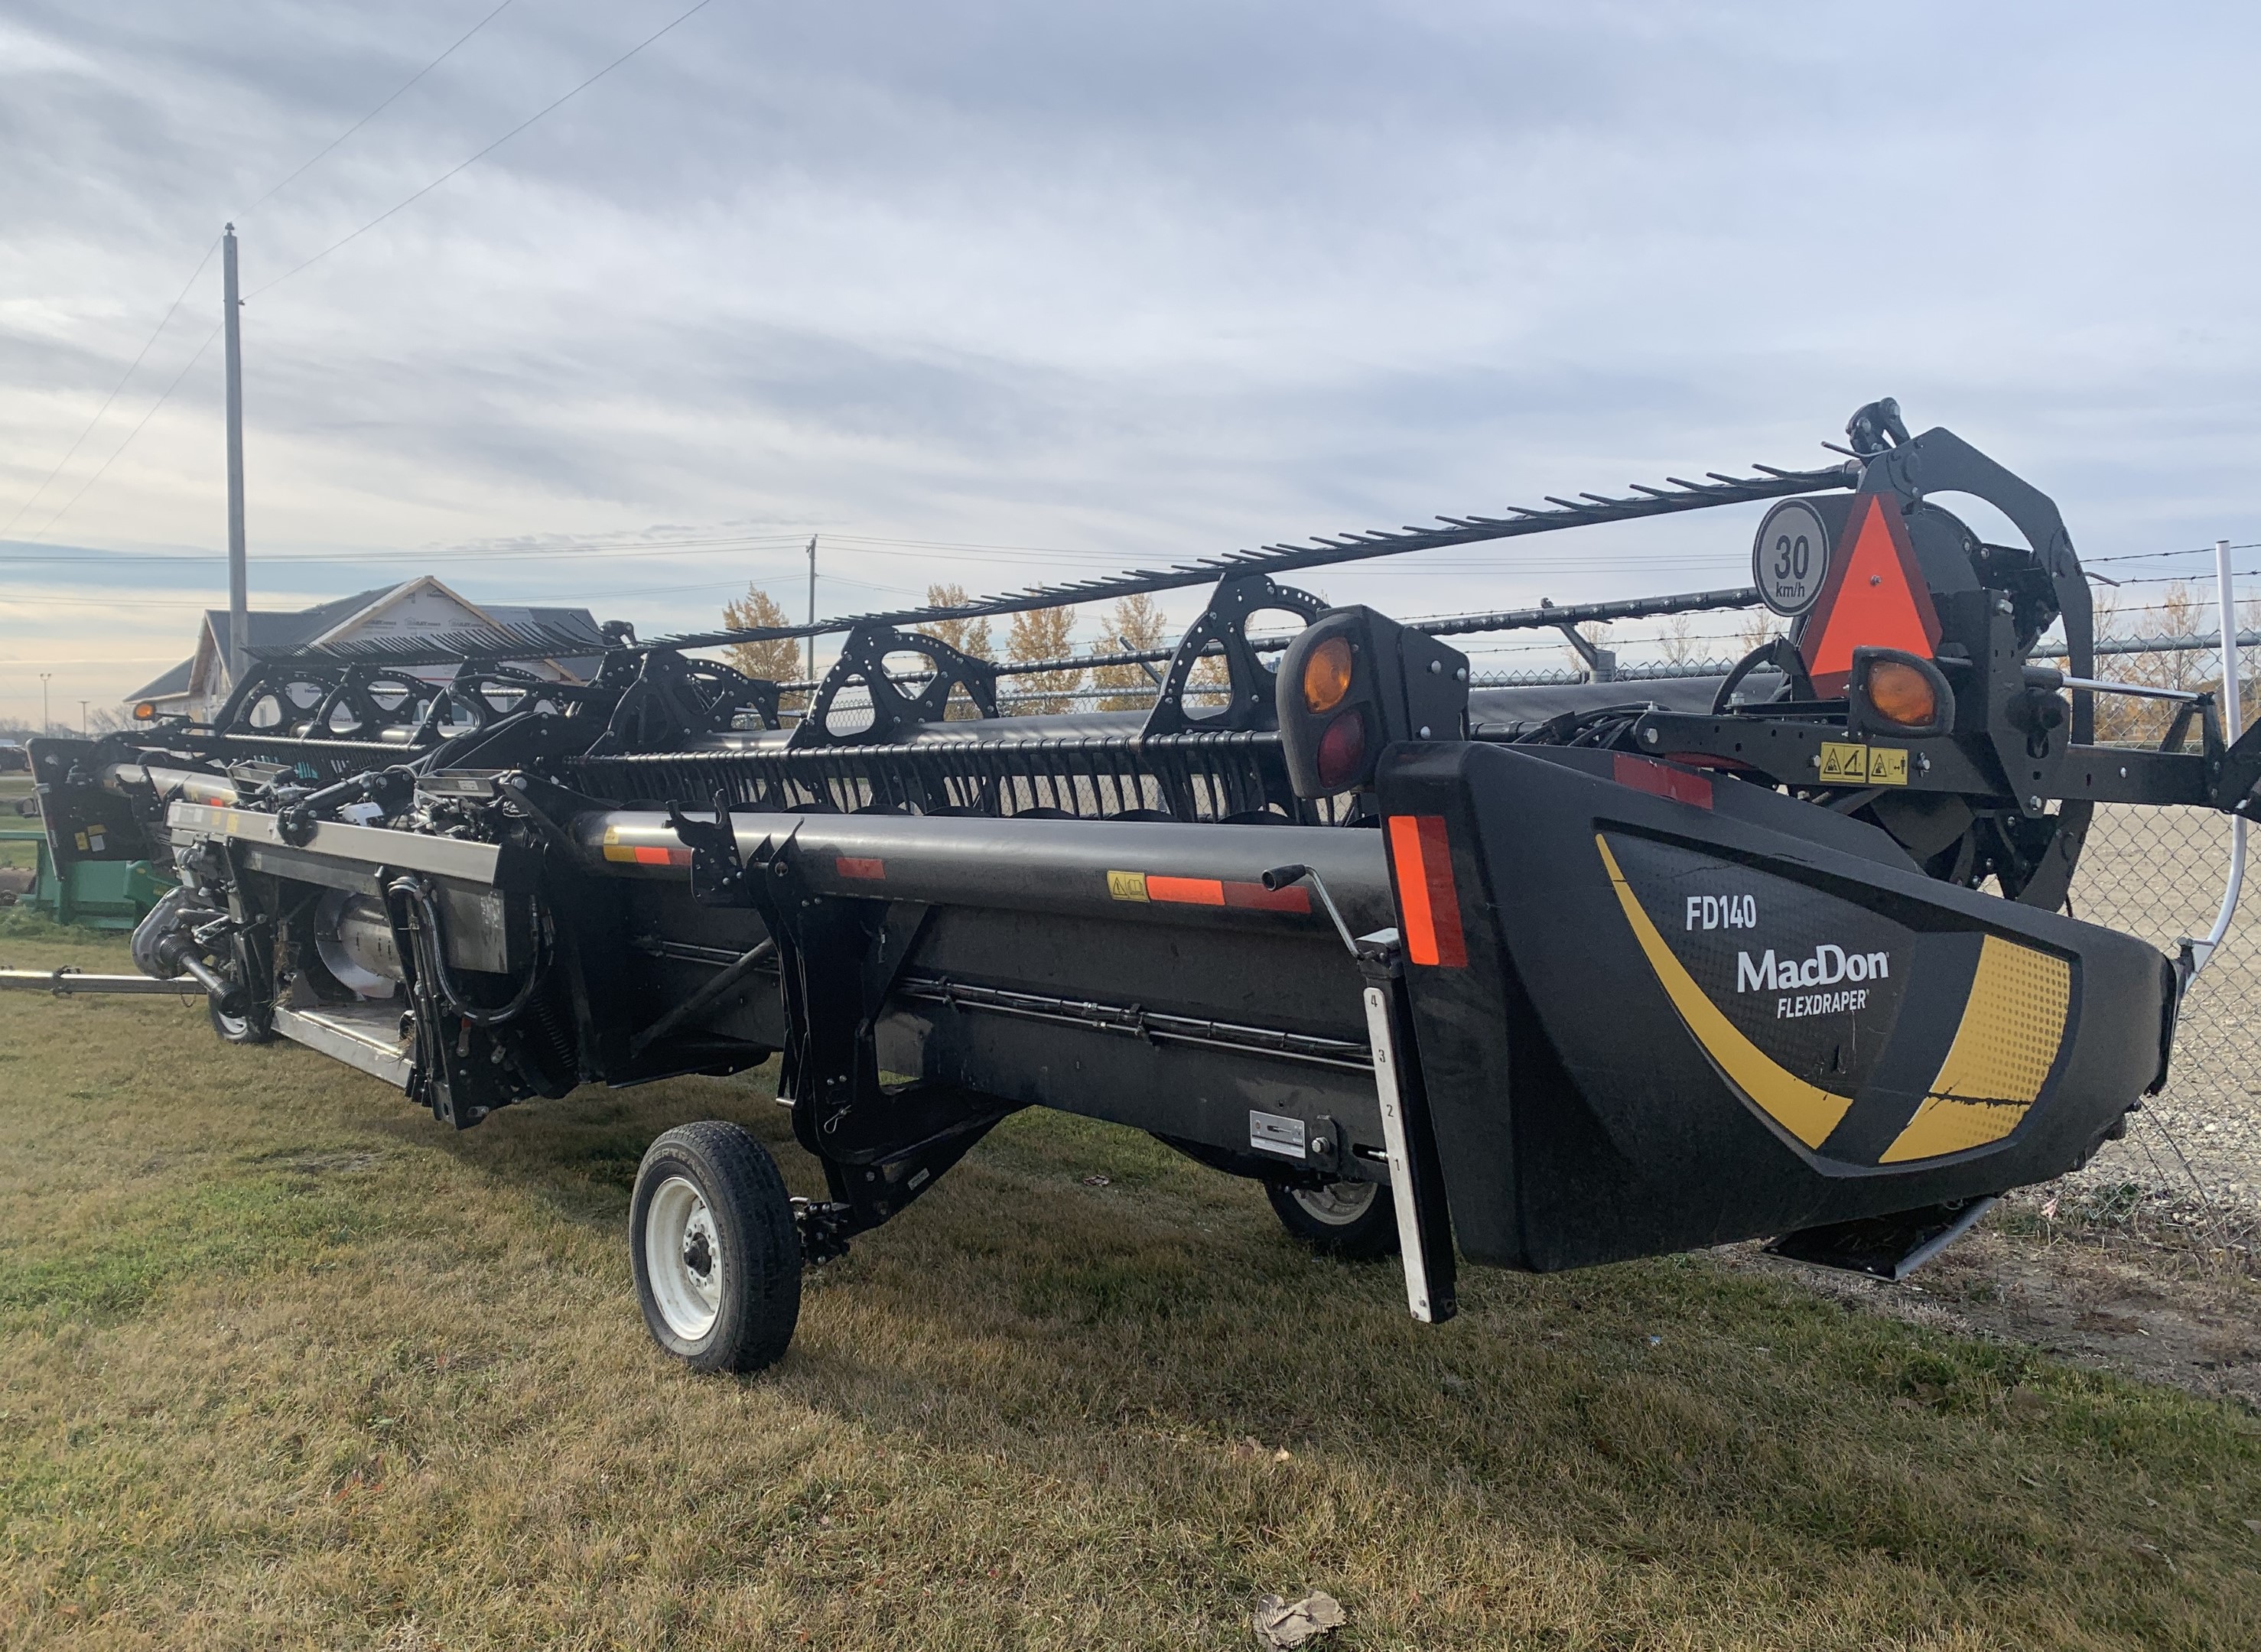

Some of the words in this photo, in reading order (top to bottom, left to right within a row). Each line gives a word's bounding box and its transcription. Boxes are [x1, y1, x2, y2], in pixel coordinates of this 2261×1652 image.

[1775, 535, 1809, 579] 30
[1776, 581, 1804, 597] km/h
[1687, 895, 1756, 931] FD140
[1737, 944, 1889, 993] MacDon
[1371, 995, 1378, 1007] 4
[1777, 990, 1866, 1019] FLEXDRAPER
[1378, 1049, 1385, 1062] 3
[1387, 1104, 1394, 1117] 2
[1394, 1159, 1401, 1171] 1
